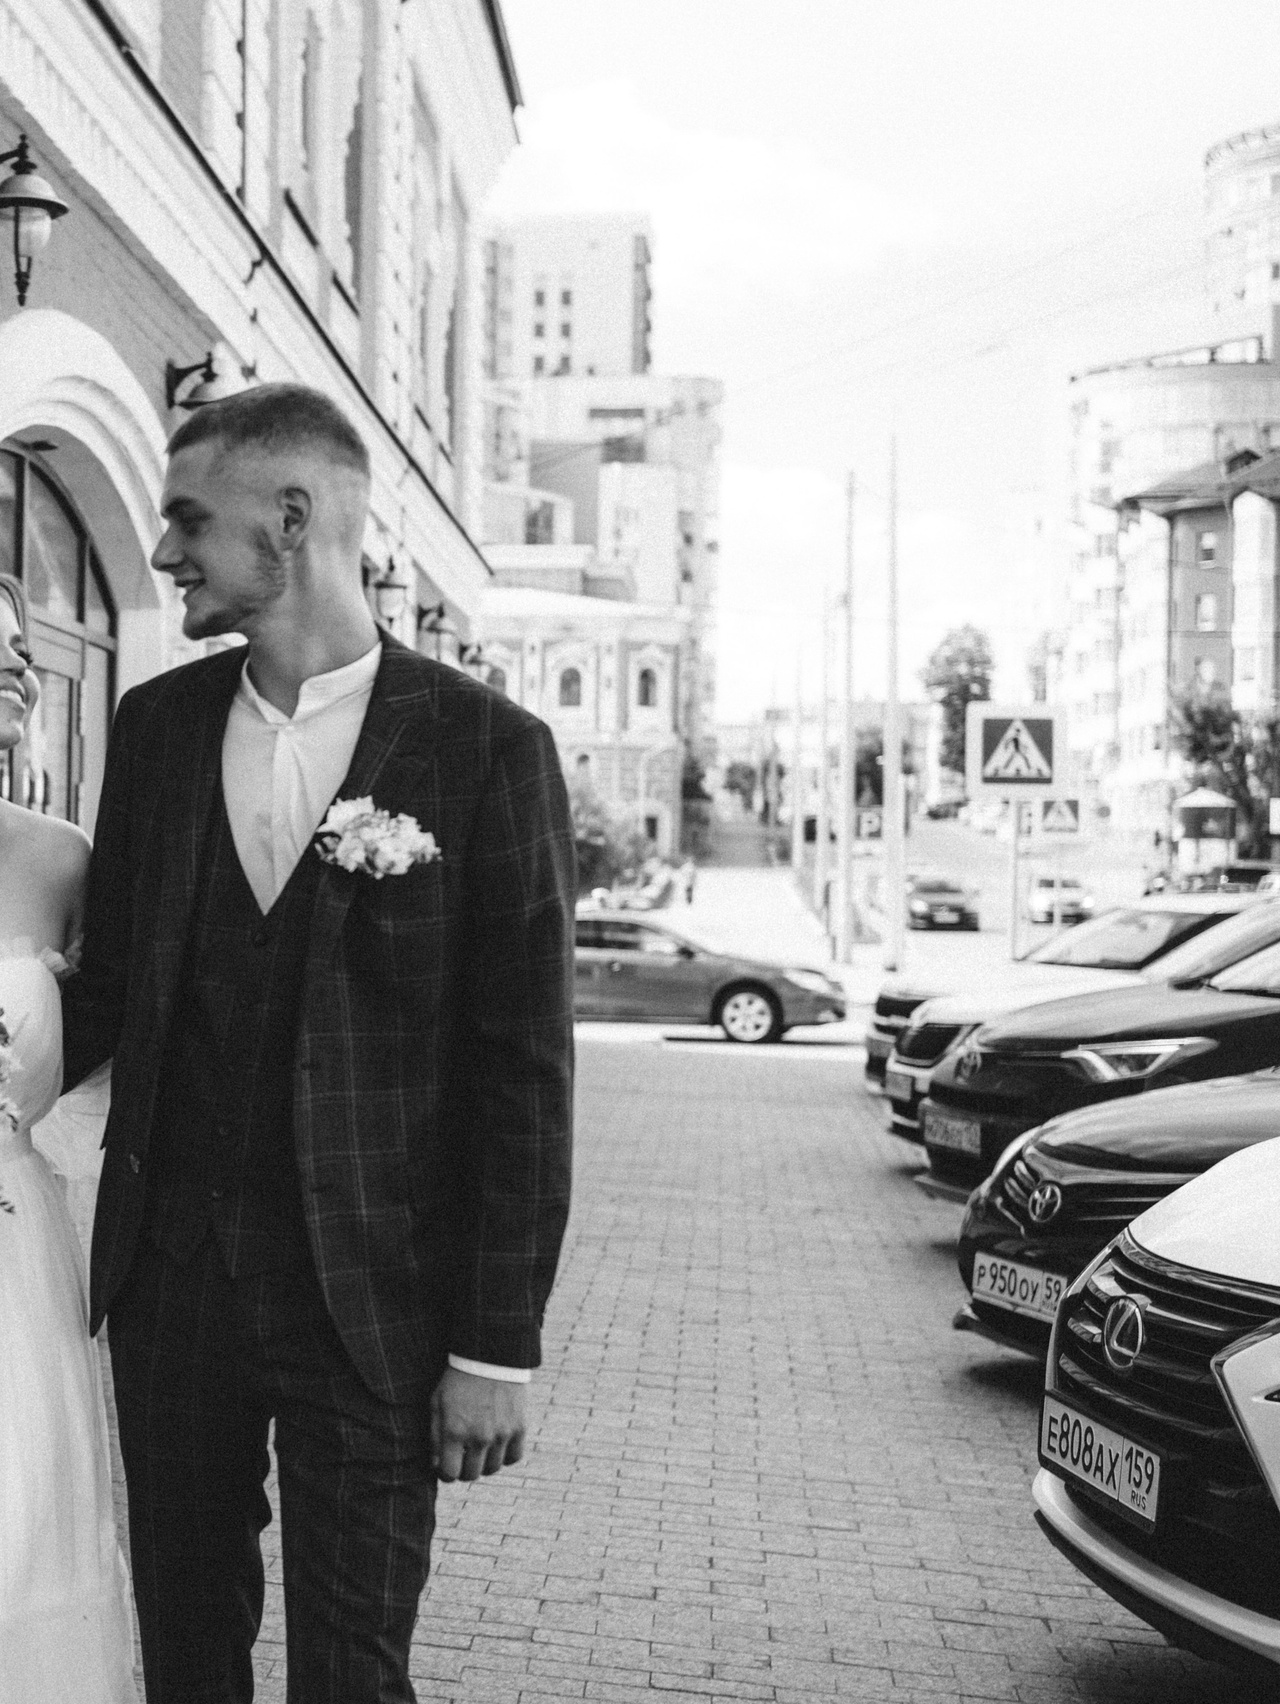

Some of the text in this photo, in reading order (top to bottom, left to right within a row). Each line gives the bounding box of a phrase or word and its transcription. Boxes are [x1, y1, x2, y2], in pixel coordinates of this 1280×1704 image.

[1045, 1277, 1062, 1303] 59
[1047, 1412, 1155, 1495] Е808АХ 159
[1130, 1489, 1147, 1511] RUS
